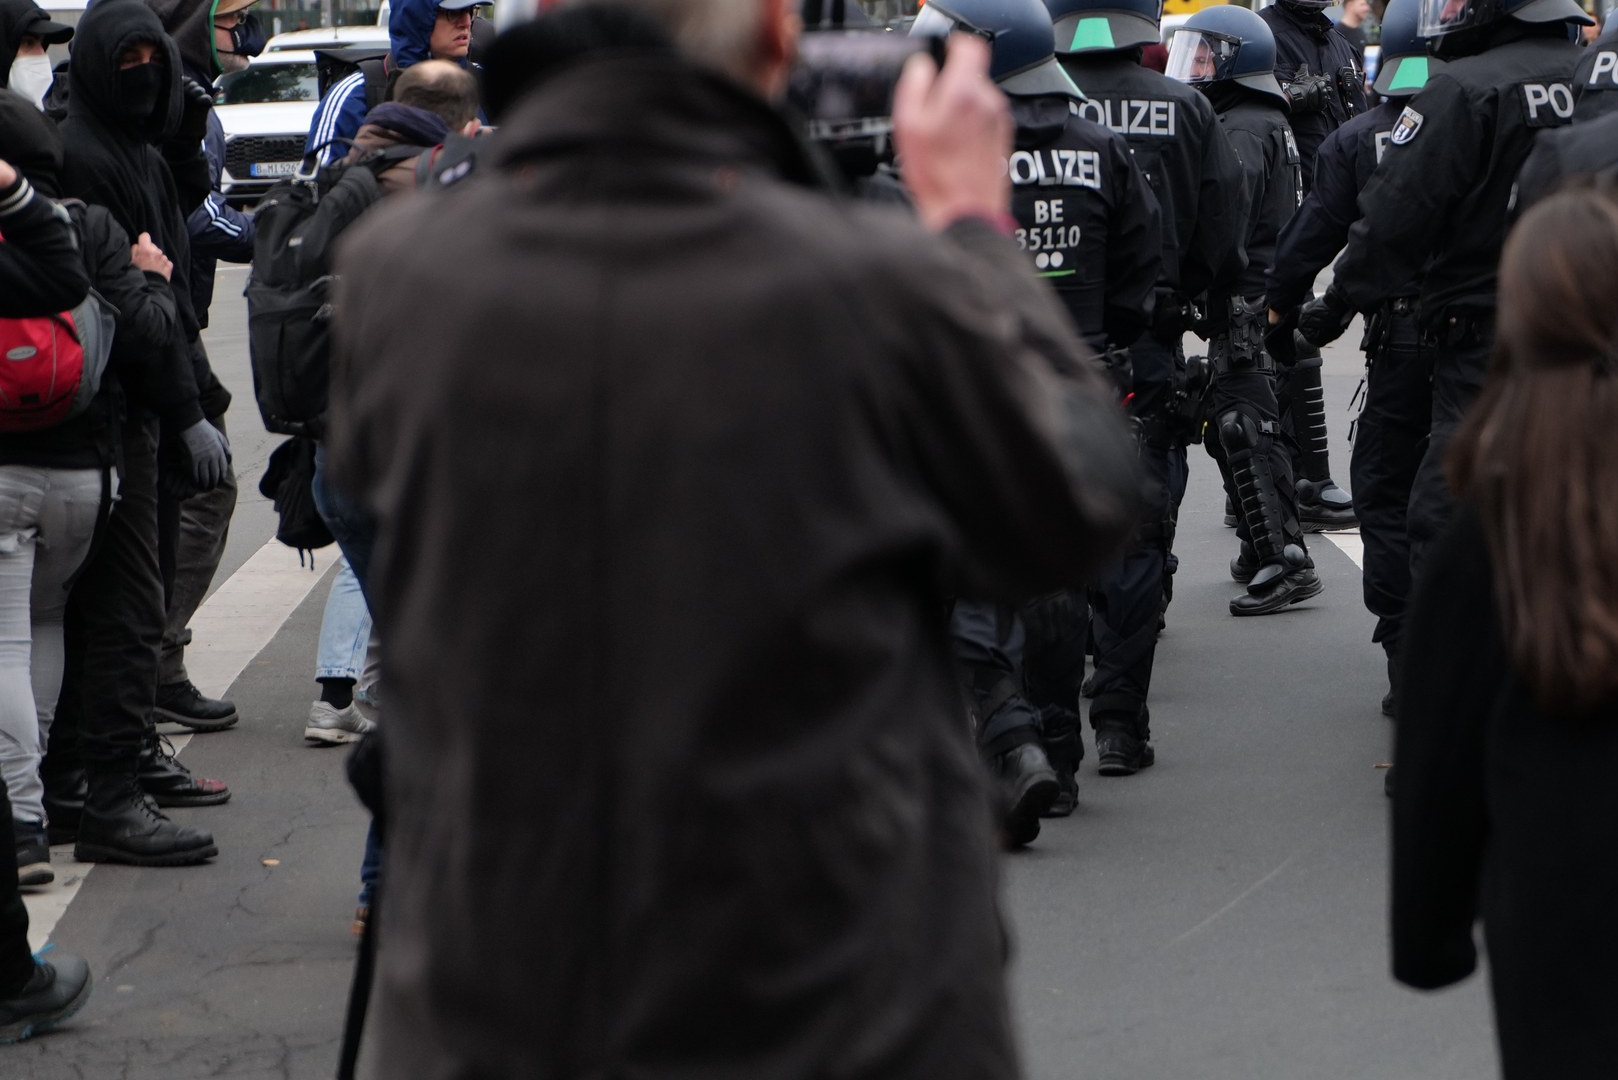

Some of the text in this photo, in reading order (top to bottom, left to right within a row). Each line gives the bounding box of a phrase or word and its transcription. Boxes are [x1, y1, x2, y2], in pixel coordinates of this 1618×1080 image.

[1008, 149, 1101, 189] OLIZEI
[1034, 199, 1064, 224] BE
[1015, 225, 1081, 251] 35110
